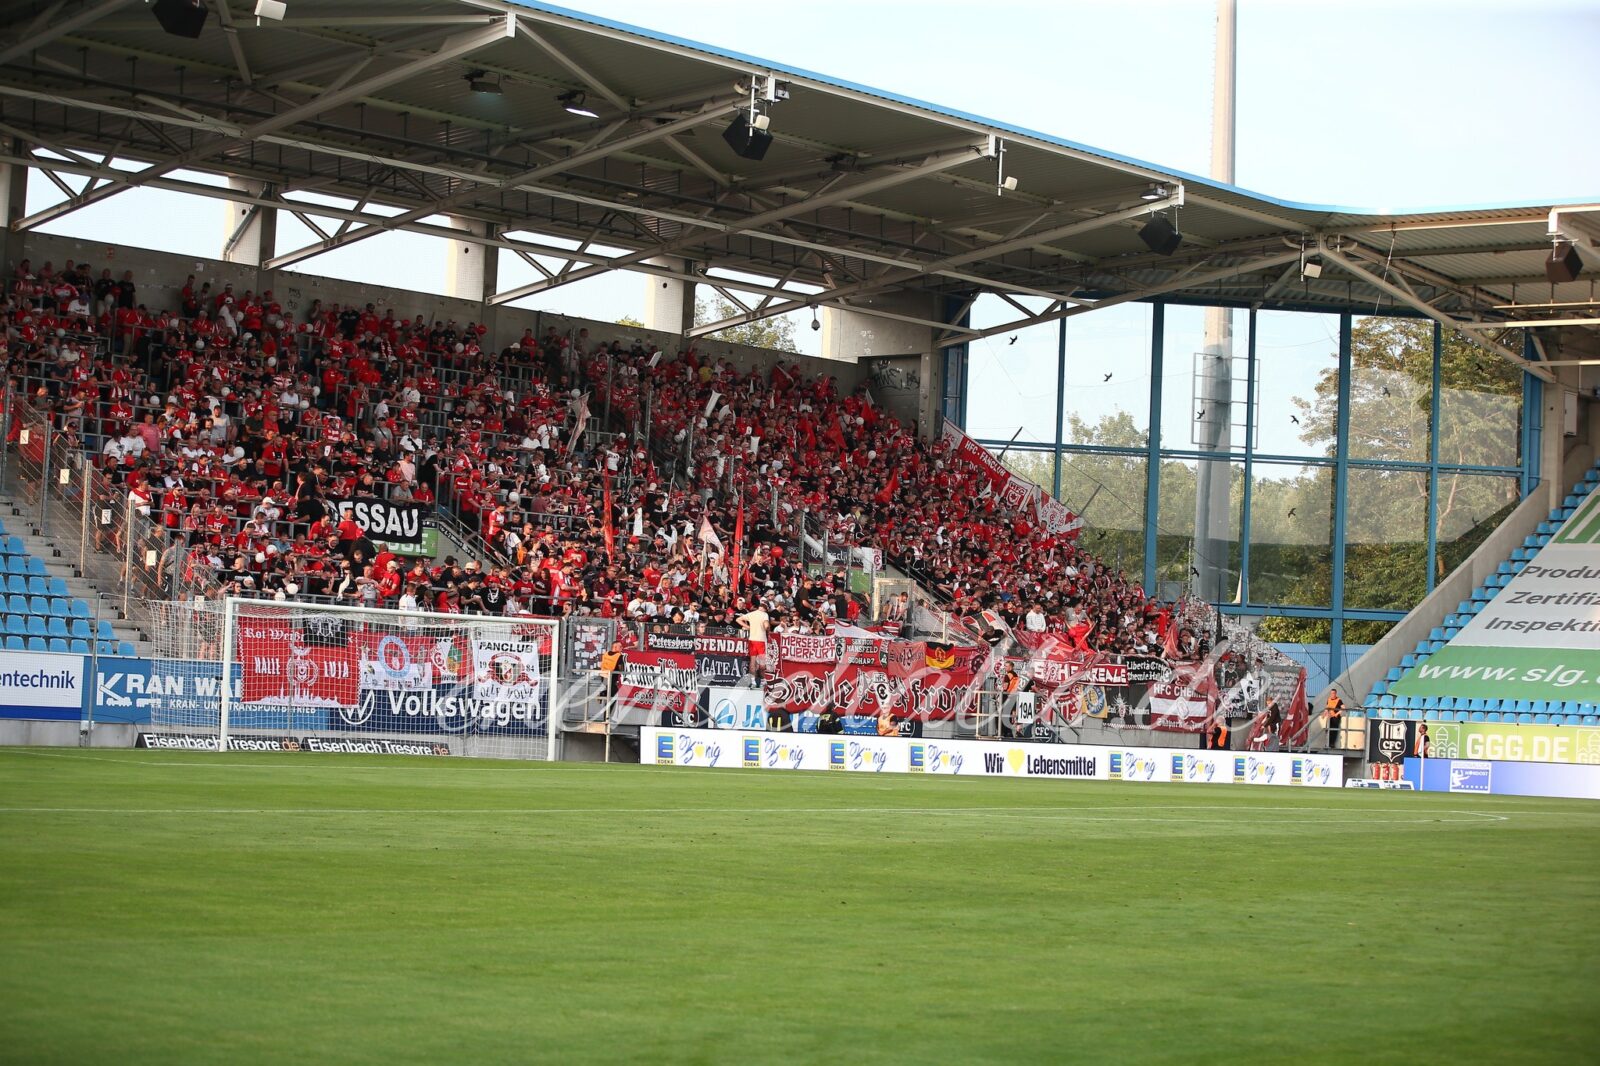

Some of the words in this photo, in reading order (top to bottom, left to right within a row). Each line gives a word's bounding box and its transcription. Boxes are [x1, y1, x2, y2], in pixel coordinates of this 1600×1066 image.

[964, 440, 978, 455] HFC
[979, 451, 1006, 478] FANCLUB
[1518, 566, 1600, 579] Produ
[244, 628, 266, 639] Rot
[1485, 617, 1600, 634] Inspekti
[480, 642, 533, 653] FANCLUB
[780, 646, 836, 659] QUERFURT
[254, 656, 281, 675] HALLE
[323, 660, 349, 679] LUJA
[1418, 664, 1600, 687] www.slg.
[0, 669, 75, 689] ntechnik
[97, 672, 184, 706] KRAN
[1153, 683, 1172, 696] HFC
[203, 700, 222, 710] UN
[389, 690, 541, 726] Volkswagen
[1019, 702, 1033, 719] 19A
[1035, 726, 1050, 737] CFC
[1382, 740, 1402, 750] CFC
[1467, 733, 1569, 763] GGG.DE
[984, 752, 1004, 773] Wir
[1027, 754, 1096, 776] Lebensmittel
